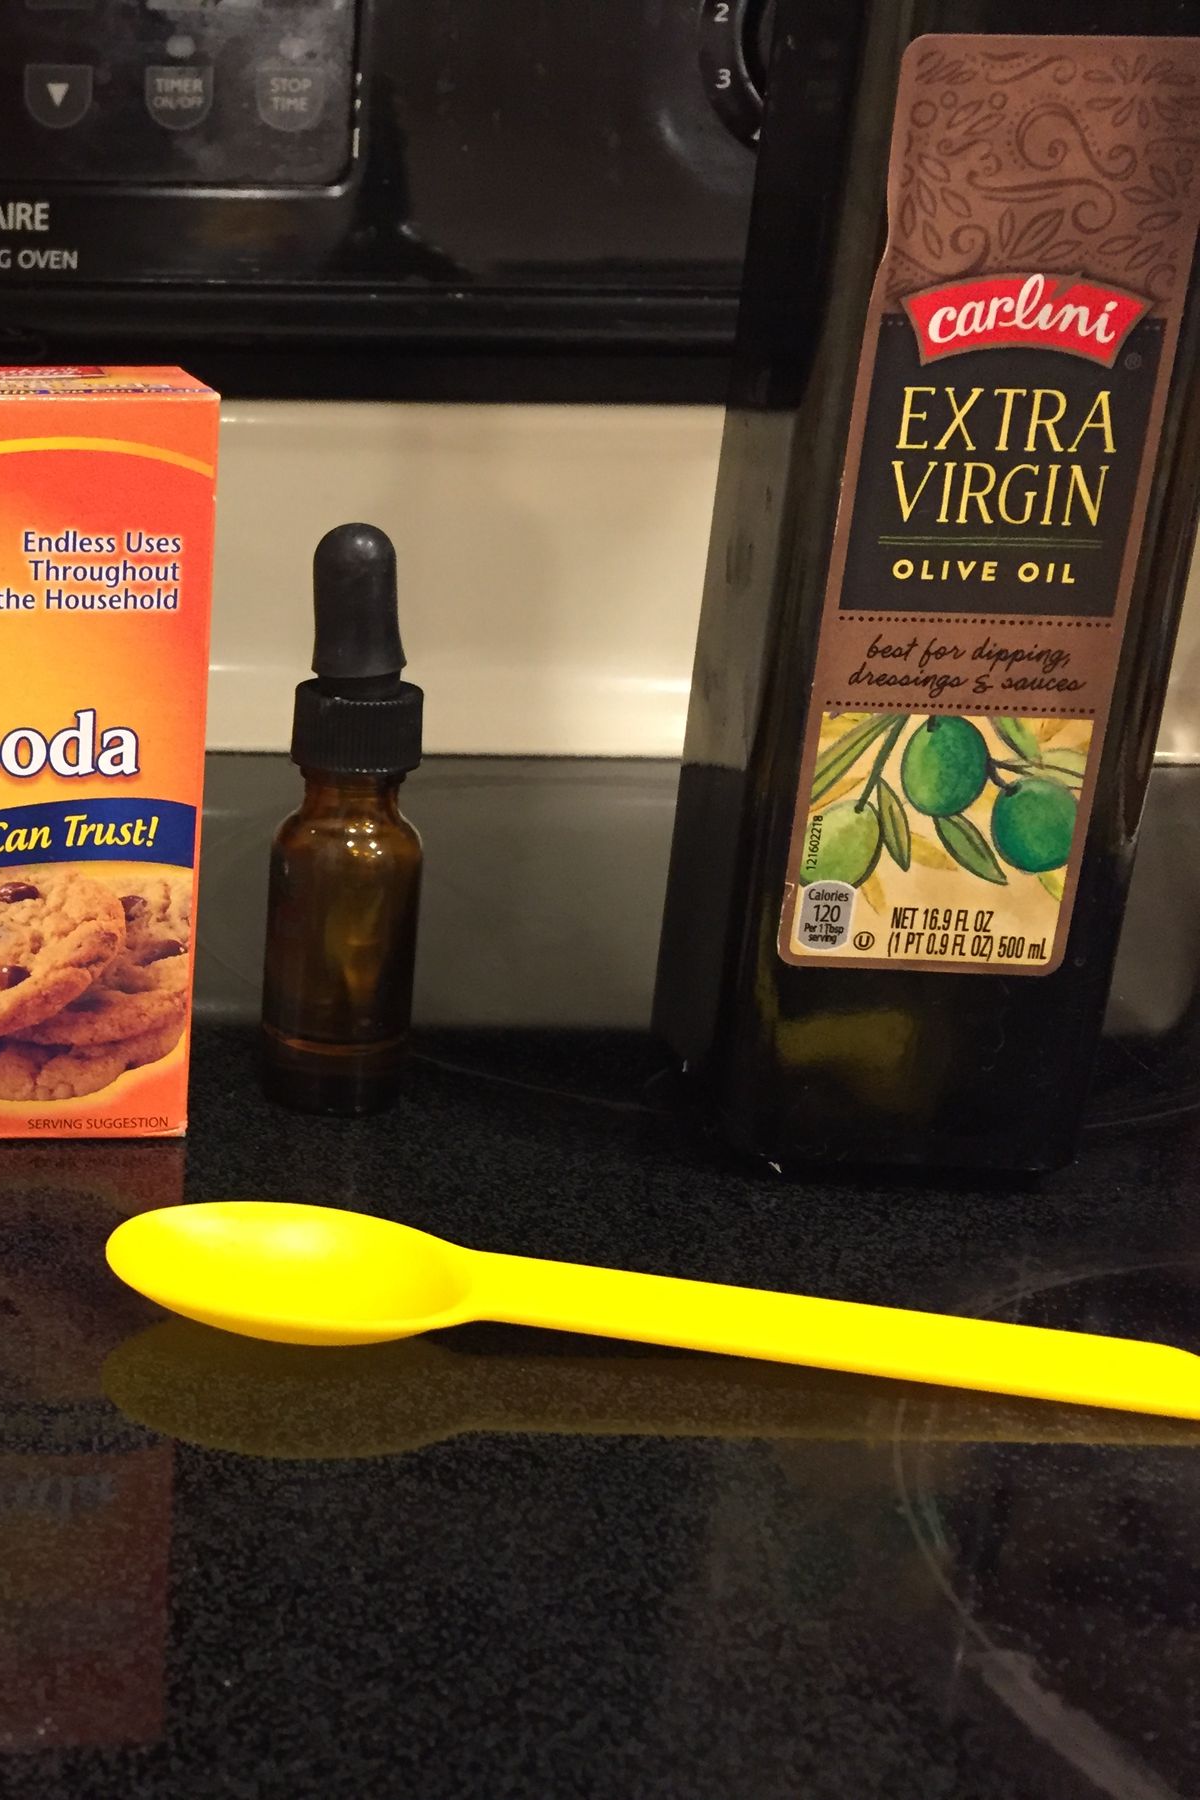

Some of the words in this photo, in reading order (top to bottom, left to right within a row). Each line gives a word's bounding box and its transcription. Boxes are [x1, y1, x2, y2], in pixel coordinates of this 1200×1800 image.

[714, 3, 730, 22] 2
[155, 78, 203, 93] TIMER
[270, 77, 312, 93] STOP
[715, 68, 731, 88] 3
[272, 97, 307, 112] TIME
[17, 250, 78, 270] OVEN
[928, 273, 1118, 344] carlini
[896, 386, 1117, 453] EXTRA
[892, 461, 1109, 527] VIRGIN
[23, 531, 116, 554] Endless
[125, 531, 182, 554] Uses
[29, 559, 180, 588] Throughout
[892, 559, 998, 582] OLIVE
[1018, 561, 1076, 584] OIL
[45, 588, 179, 611] Household
[866, 634, 919, 661] best
[921, 638, 965, 667] for
[849, 662, 969, 698] dressings
[974, 674, 993, 693] &
[1002, 674, 1087, 692] sauces
[64, 814, 160, 848] Trust!
[808, 888, 849, 902] Calories
[813, 905, 841, 922] 120
[891, 907, 918, 930] NET
[922, 908, 951, 931] 16.9
[955, 910, 970, 933] FL
[974, 910, 994, 934] OZ
[804, 923, 817, 933] Per
[824, 924, 844, 936] Tbsp
[808, 934, 837, 945] serving
[887, 931, 901, 958] (1
[905, 932, 925, 955] PT
[926, 933, 947, 956] 0.9
[950, 934, 968, 957] FL
[971, 935, 994, 962] OZ)
[997, 936, 1025, 959] 500
[1027, 937, 1047, 961] mL
[27, 1117, 82, 1130] SERVING
[85, 1117, 169, 1130] SUGGESTION
